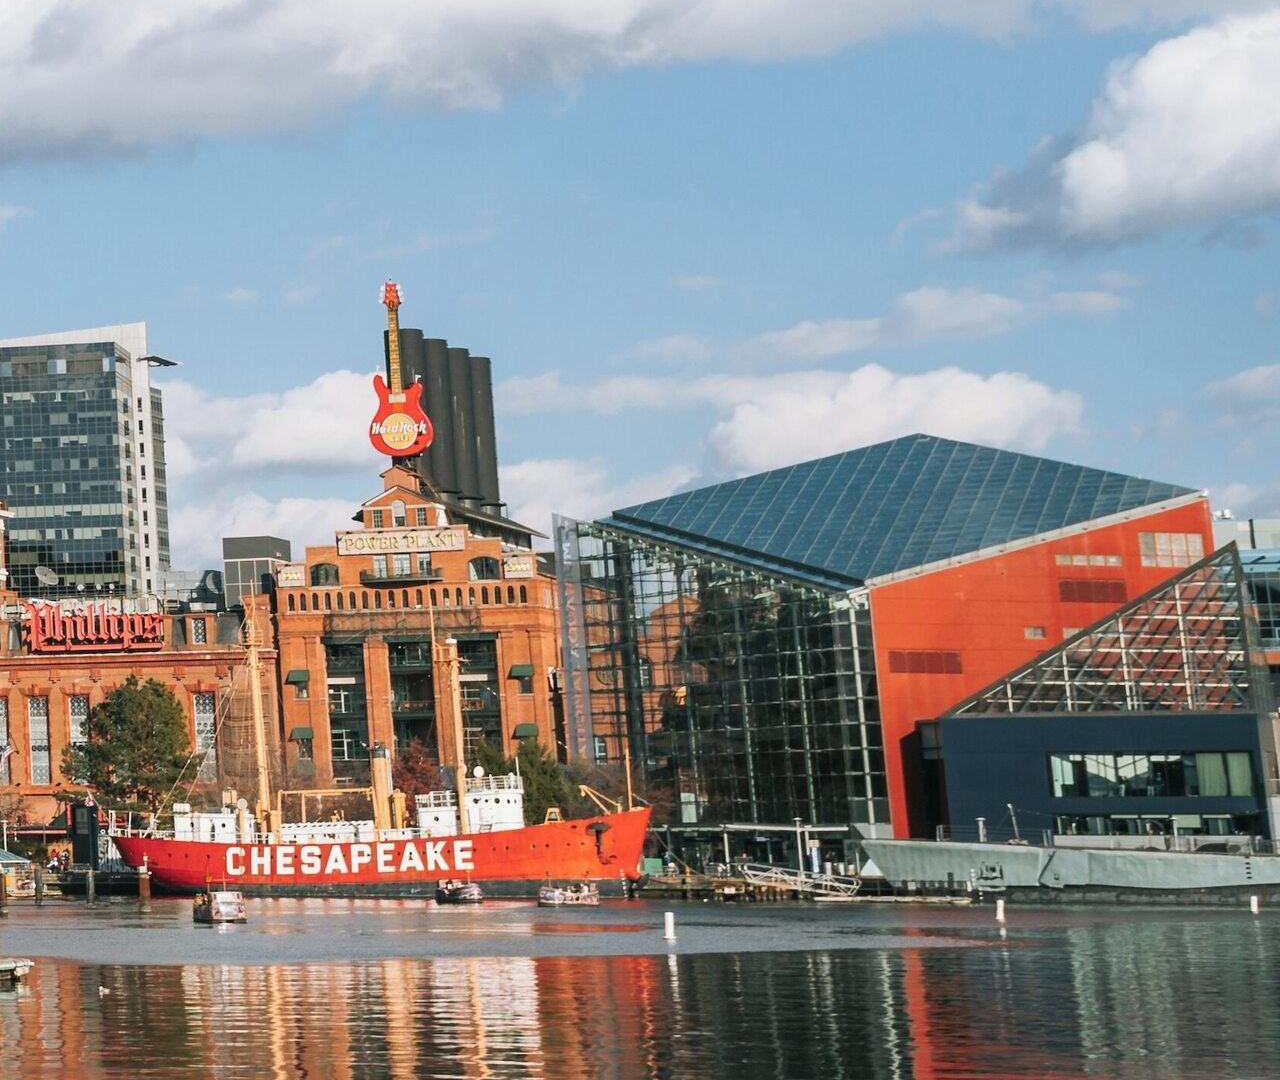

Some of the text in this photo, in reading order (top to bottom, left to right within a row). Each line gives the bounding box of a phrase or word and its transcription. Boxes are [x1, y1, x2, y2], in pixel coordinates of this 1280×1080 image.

[371, 420, 427, 435] Hard Rock
[345, 530, 457, 551] POWER PLANT
[24, 602, 164, 651] Phillips
[571, 668, 587, 761] ATIONAL
[225, 839, 475, 876] CHESAPEAKE
